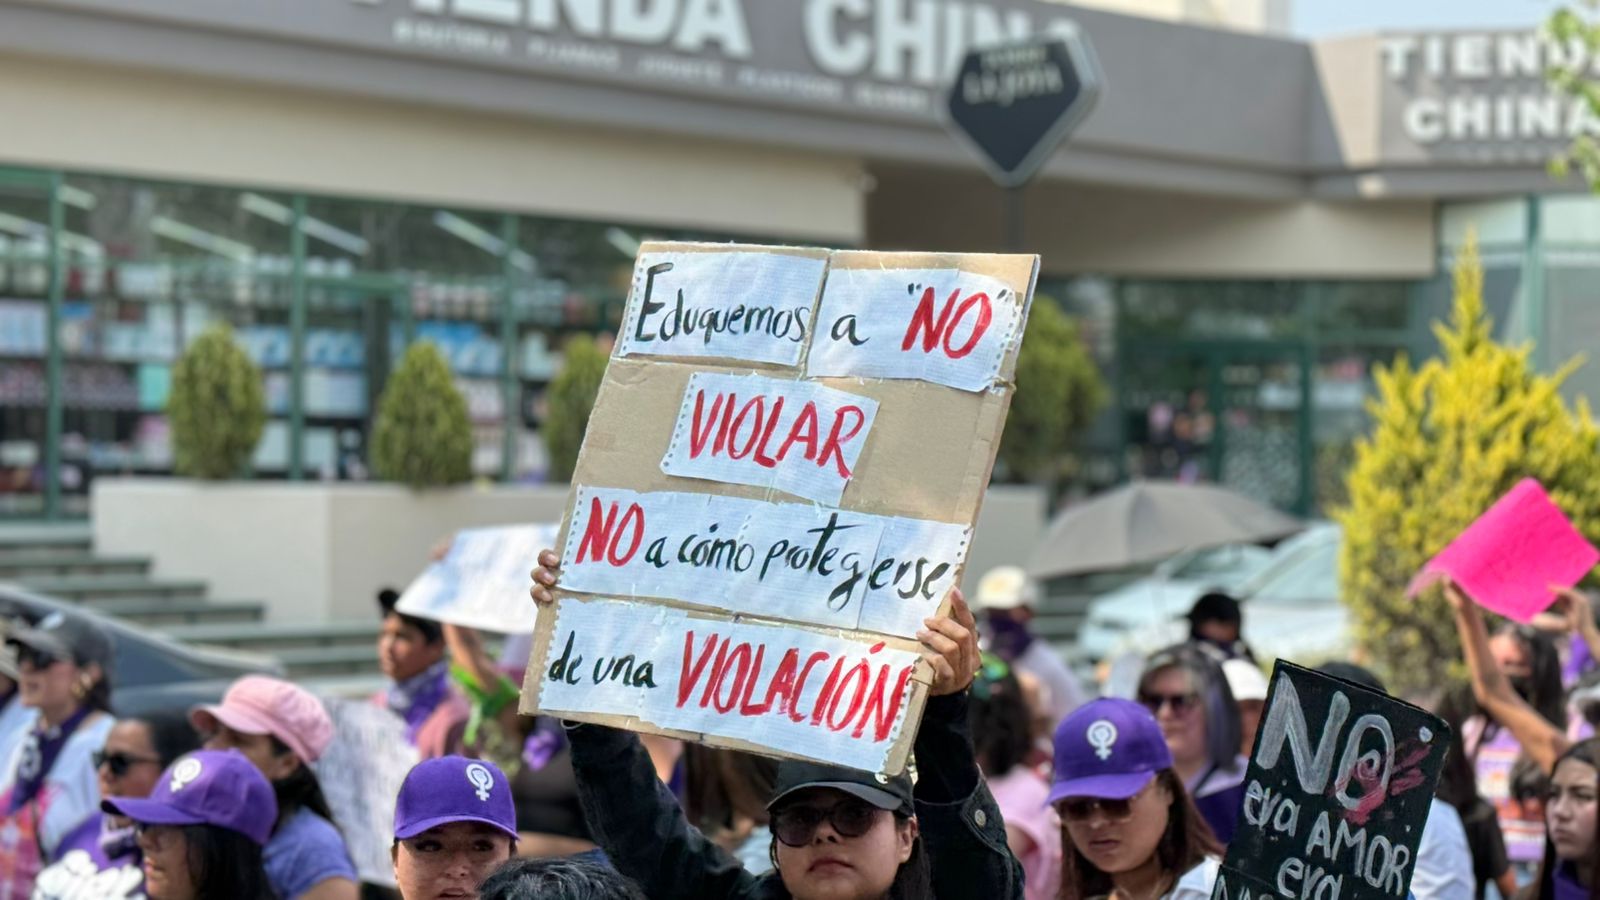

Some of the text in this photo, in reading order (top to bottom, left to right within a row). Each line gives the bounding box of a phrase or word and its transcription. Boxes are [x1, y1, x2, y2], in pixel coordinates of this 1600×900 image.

[802, 0, 1083, 82] CHI
[1379, 34, 1600, 77] TIEND
[635, 262, 810, 344] Eduquemos
[831, 314, 870, 346] a
[688, 389, 865, 479] VIOLAR
[575, 496, 645, 567] NO
[644, 536, 669, 568] a
[759, 512, 951, 613] protegerse
[548, 630, 914, 743] de una VIOLACIÓN
[1255, 670, 1395, 811] NO
[1277, 856, 1343, 900] era
[1305, 810, 1410, 896] AMOR
